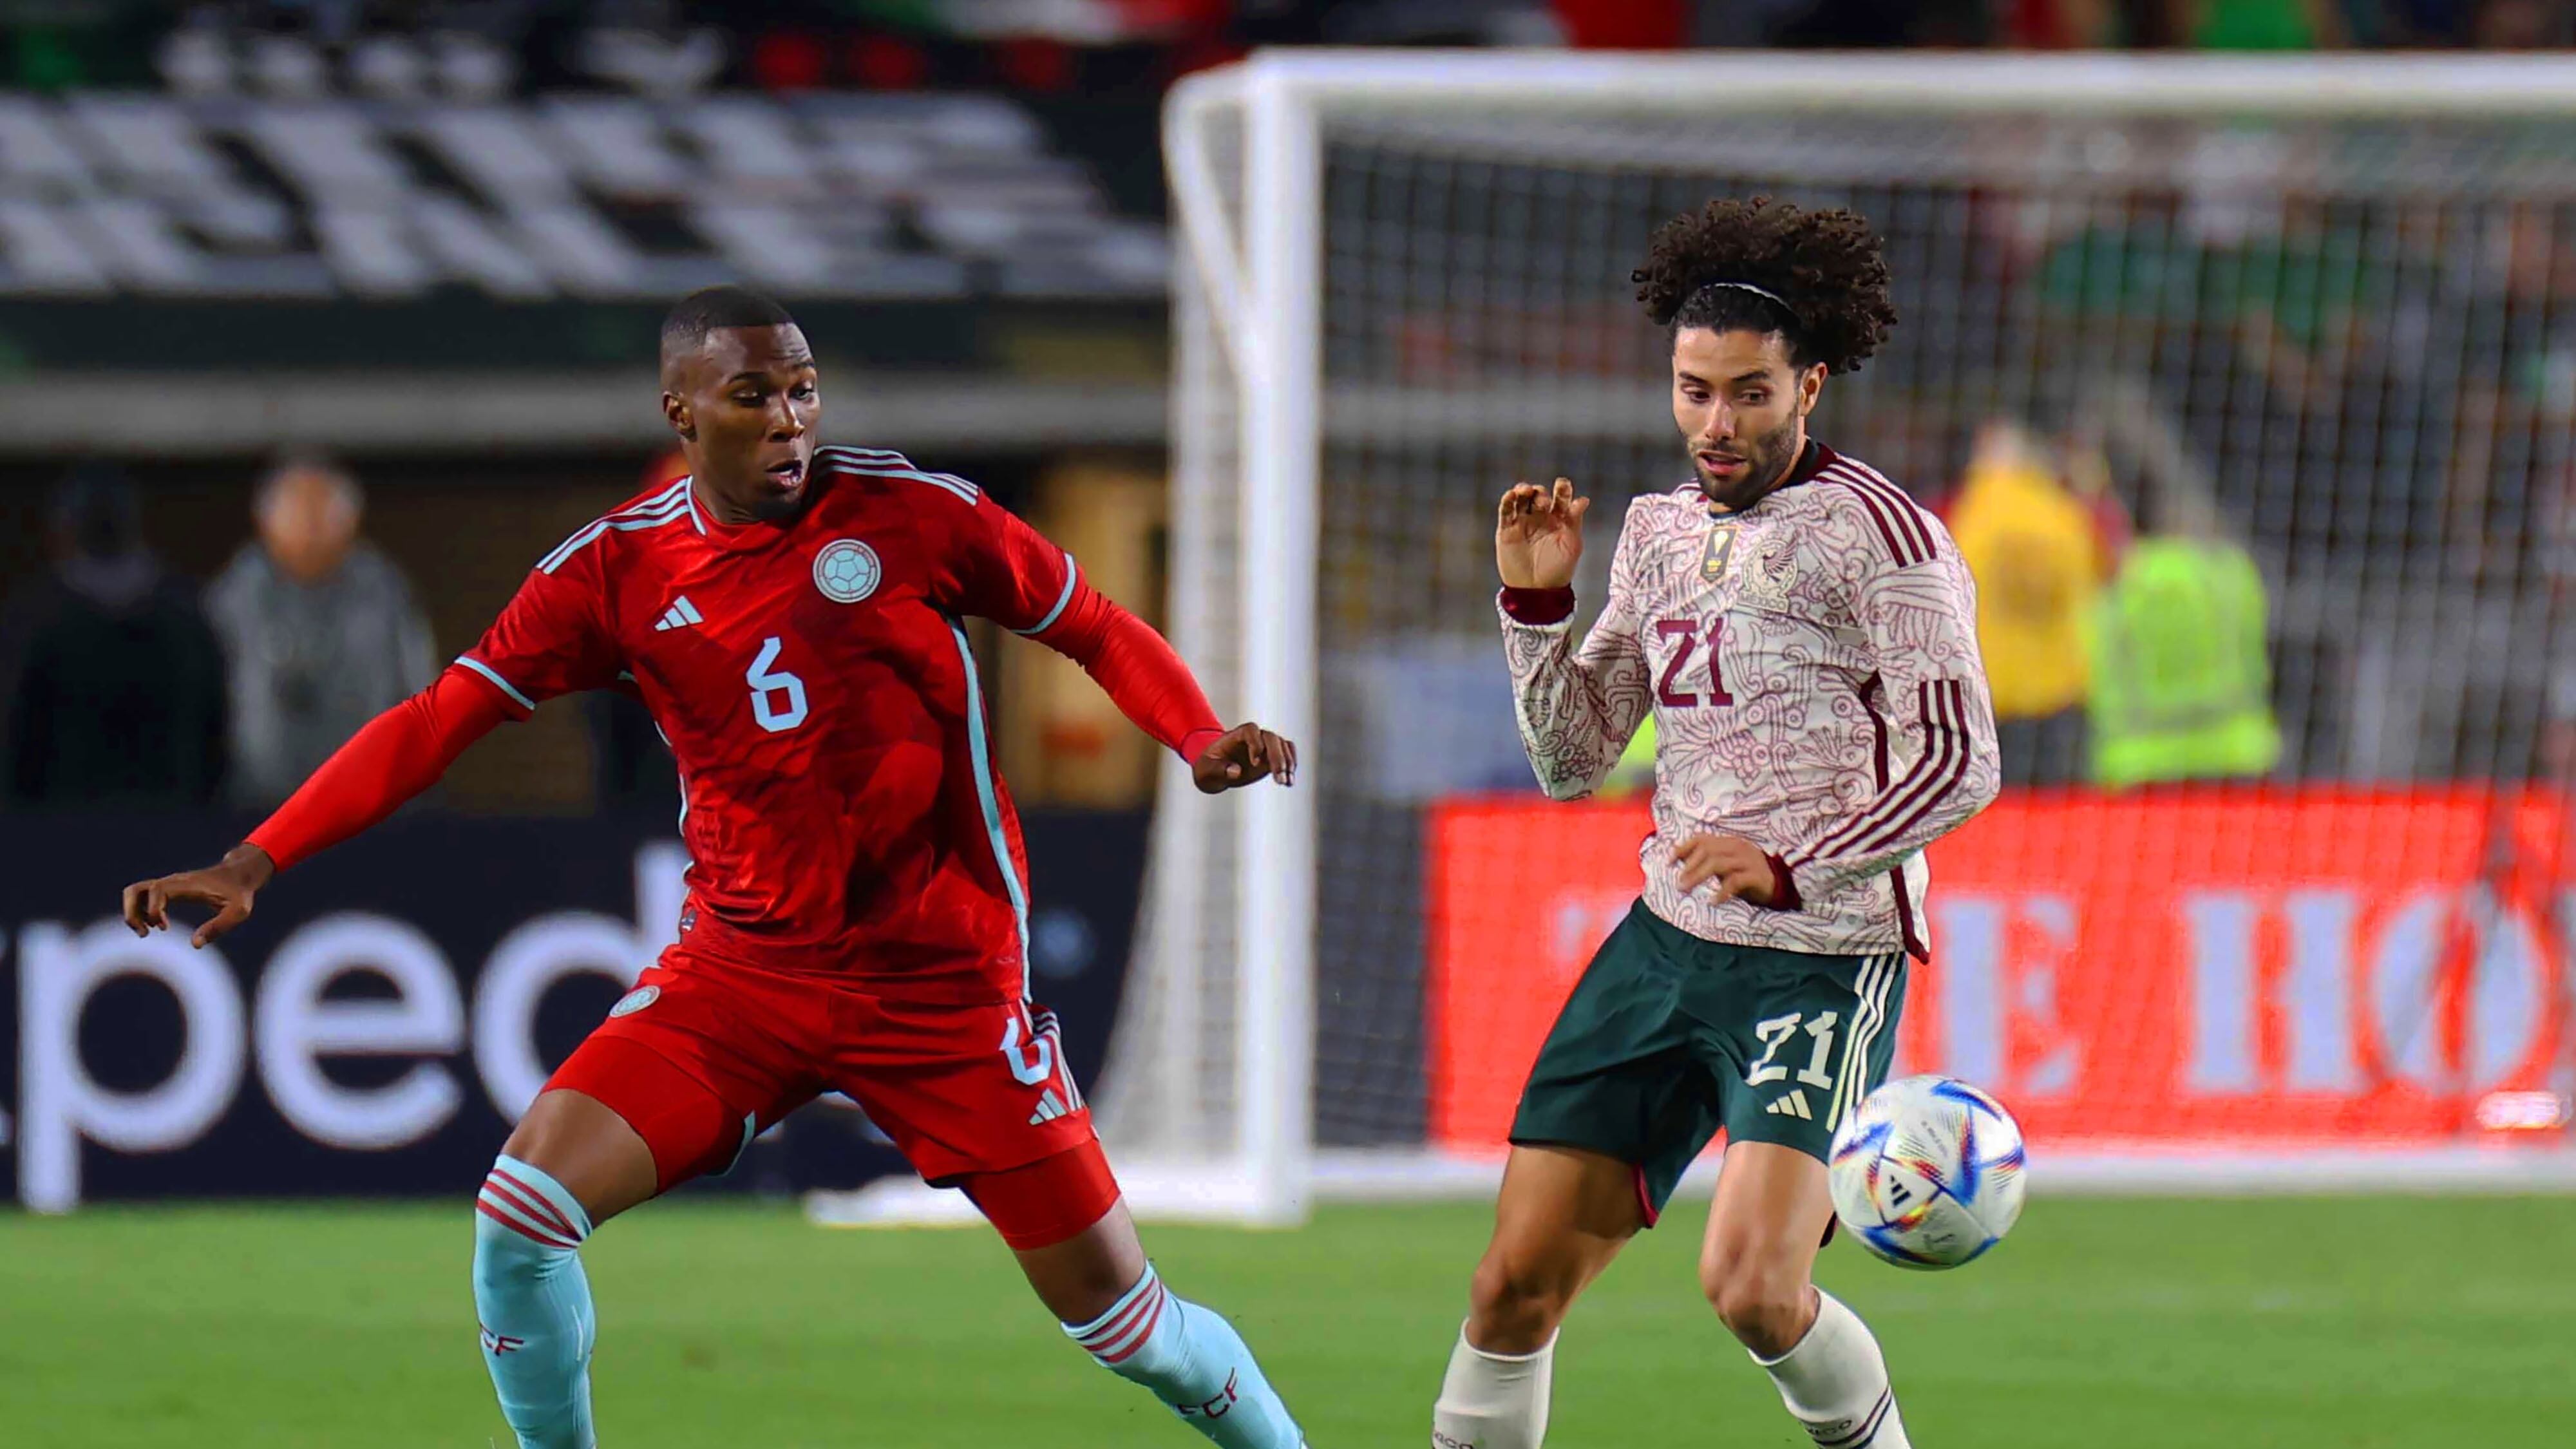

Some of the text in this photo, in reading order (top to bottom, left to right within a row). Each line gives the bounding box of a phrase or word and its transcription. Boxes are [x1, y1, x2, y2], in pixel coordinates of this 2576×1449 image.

[746, 636, 809, 733] 6
[1656, 617, 1734, 708] 21
[0, 841, 692, 1215] ped
[2181, 884, 2576, 1099] HO
[1745, 1009, 1839, 1092] 21
